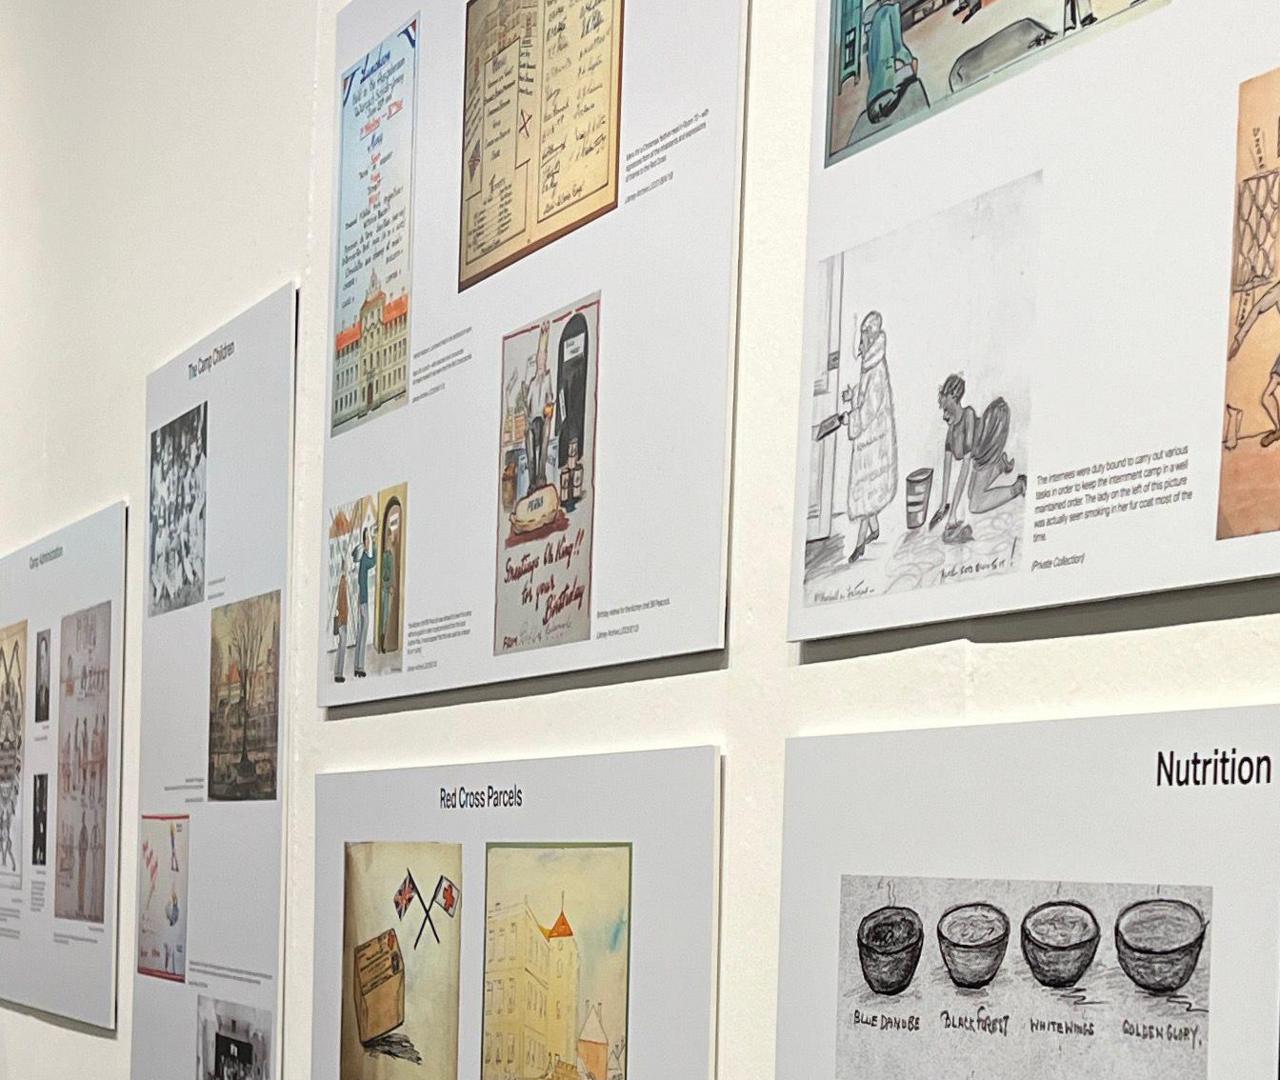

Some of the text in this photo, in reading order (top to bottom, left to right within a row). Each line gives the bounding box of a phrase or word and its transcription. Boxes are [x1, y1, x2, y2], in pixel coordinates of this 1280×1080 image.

[188, 341, 235, 380] The Camp Children
[1157, 748, 1272, 788] Nutrition
[440, 783, 523, 809] Red Cross Parcels
[853, 1009, 920, 1032] BLUE DANUBE
[940, 1006, 1010, 1036] BLACK FOREST
[1030, 1017, 1065, 1034] WHITE
[1122, 1019, 1203, 1050] GOLDEN GLORY.
